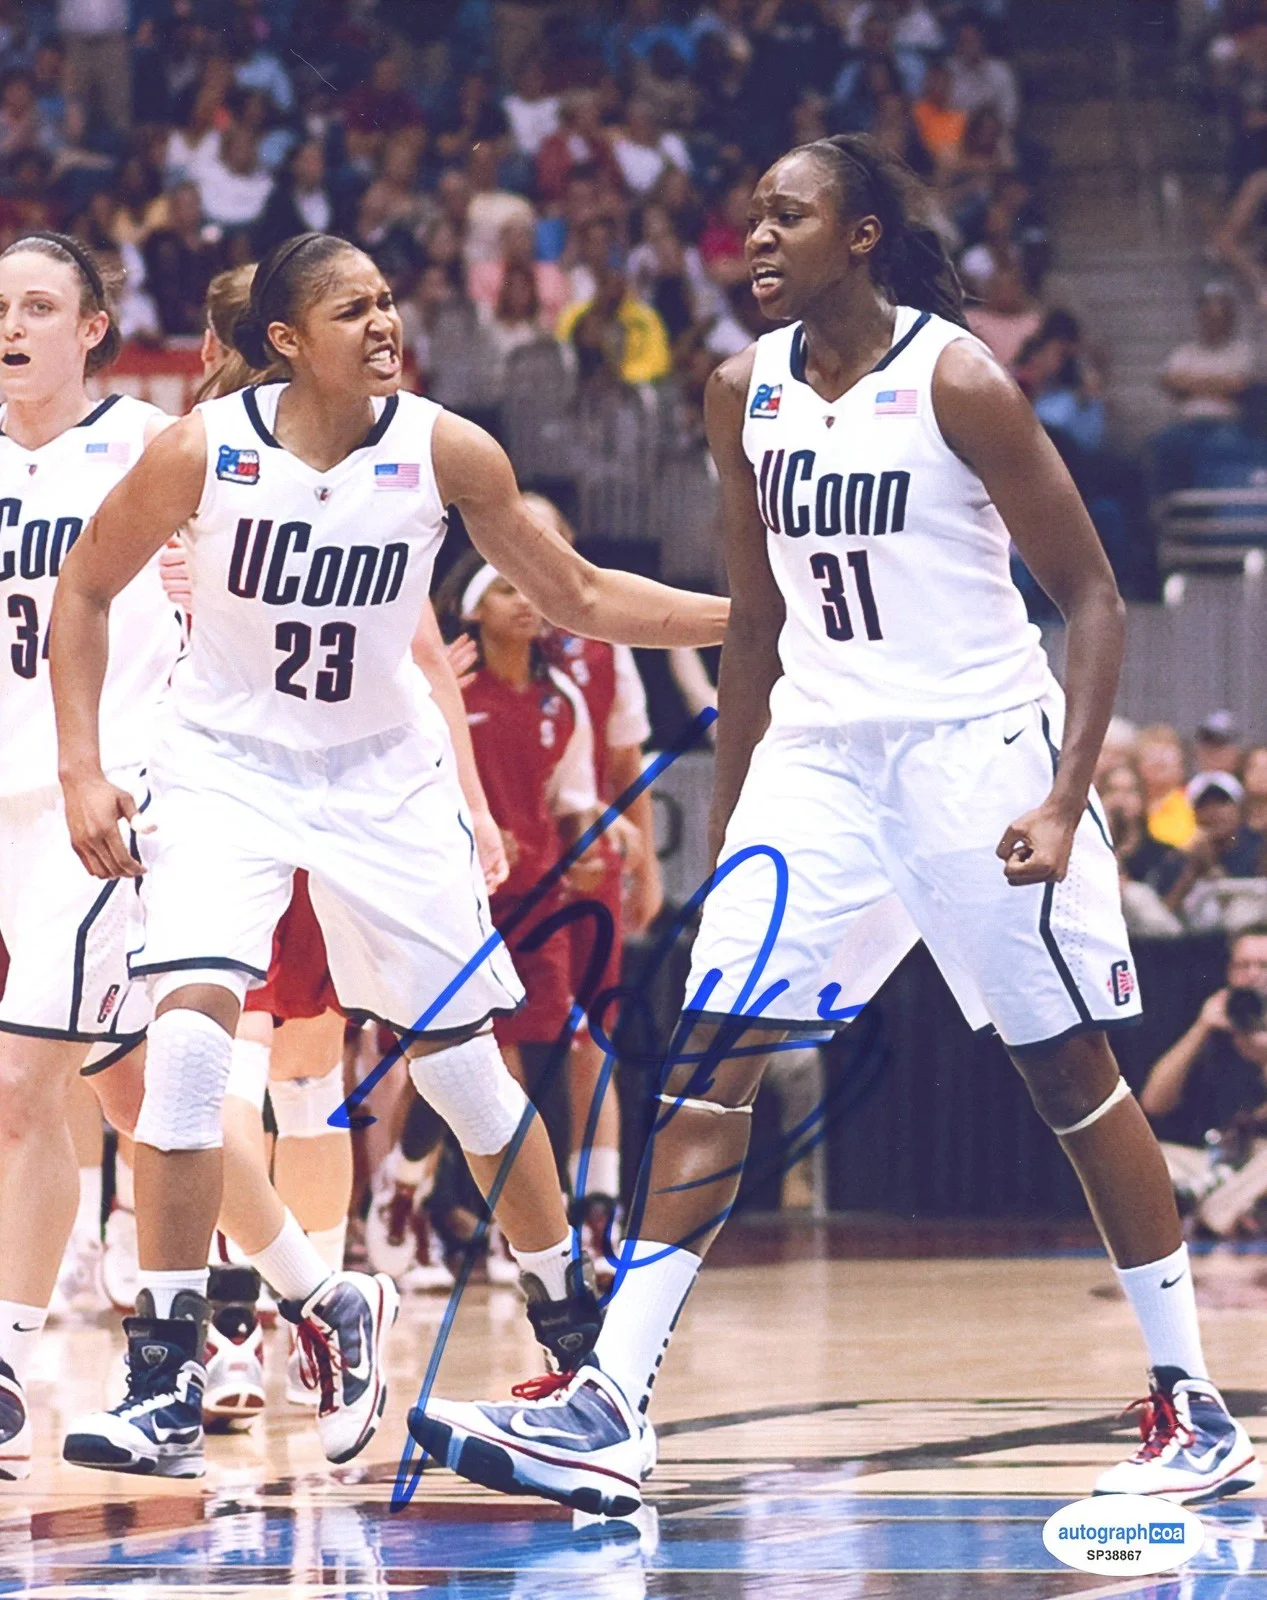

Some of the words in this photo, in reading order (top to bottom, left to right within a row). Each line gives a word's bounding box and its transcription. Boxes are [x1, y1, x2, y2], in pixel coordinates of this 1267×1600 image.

[758, 449, 911, 538] UConn
[0, 497, 94, 581] Con
[228, 518, 409, 607] UConn
[7, 593, 51, 680] 3
[809, 550, 884, 641] 31
[275, 621, 357, 703] 23
